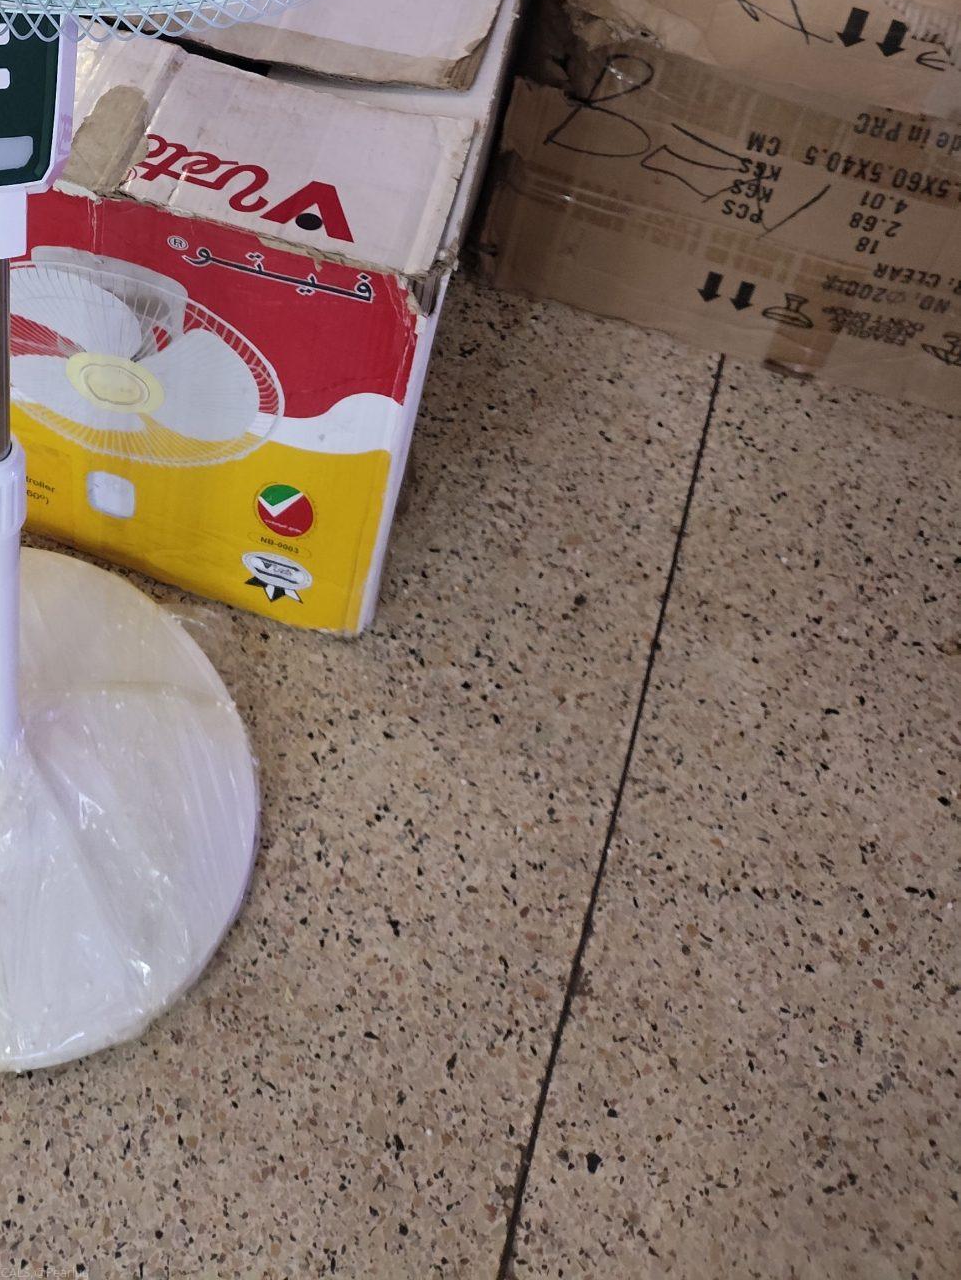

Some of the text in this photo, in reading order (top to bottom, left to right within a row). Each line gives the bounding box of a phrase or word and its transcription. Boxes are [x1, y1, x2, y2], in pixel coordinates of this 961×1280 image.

[854, 112, 903, 143] PRC
[745, 130, 782, 157] CM
[859, 189, 909, 215] 4.01
[721, 199, 881, 255] 18 PCS
[848, 211, 902, 238] 2.68
[872, 262, 941, 290] CLEAR
